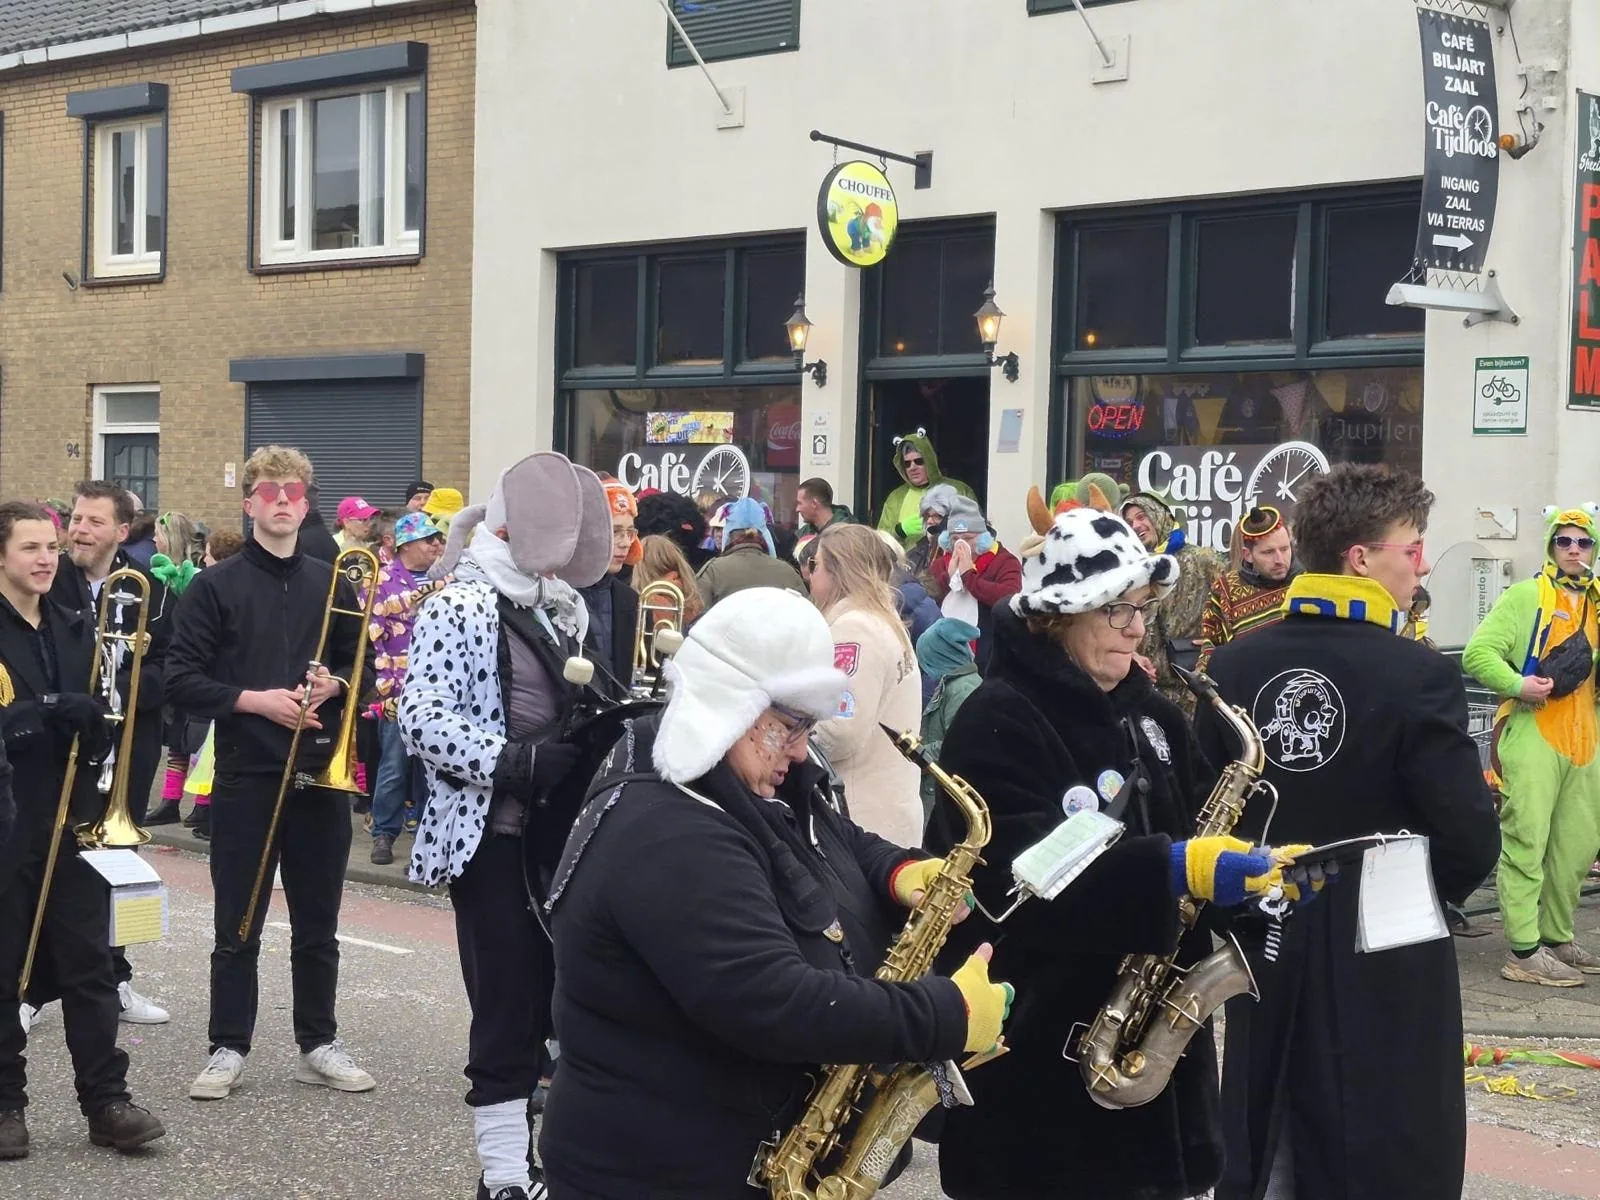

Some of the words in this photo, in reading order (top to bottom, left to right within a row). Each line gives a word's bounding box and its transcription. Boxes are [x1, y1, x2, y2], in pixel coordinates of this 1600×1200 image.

[1441, 32, 1475, 52] CAFÉ
[1432, 52, 1485, 76] BILJART
[1444, 76, 1479, 96] ZAAL
[1426, 101, 1464, 129] Café
[1432, 126, 1497, 158] Tijdloos
[1578, 152, 1600, 173] Speci
[838, 178, 892, 201] CHOUFFE
[1441, 175, 1480, 193] INGANG
[1445, 195, 1472, 212] ZAAL
[1427, 211, 1444, 227] VIA
[1446, 214, 1485, 232] TERRAS
[1088, 404, 1145, 431] OPEN
[1335, 418, 1421, 446] Jupiler
[66, 442, 80, 458] 94
[618, 452, 690, 495] Café
[1138, 451, 1243, 501] Café
[1477, 576, 1487, 625] oplaadp
